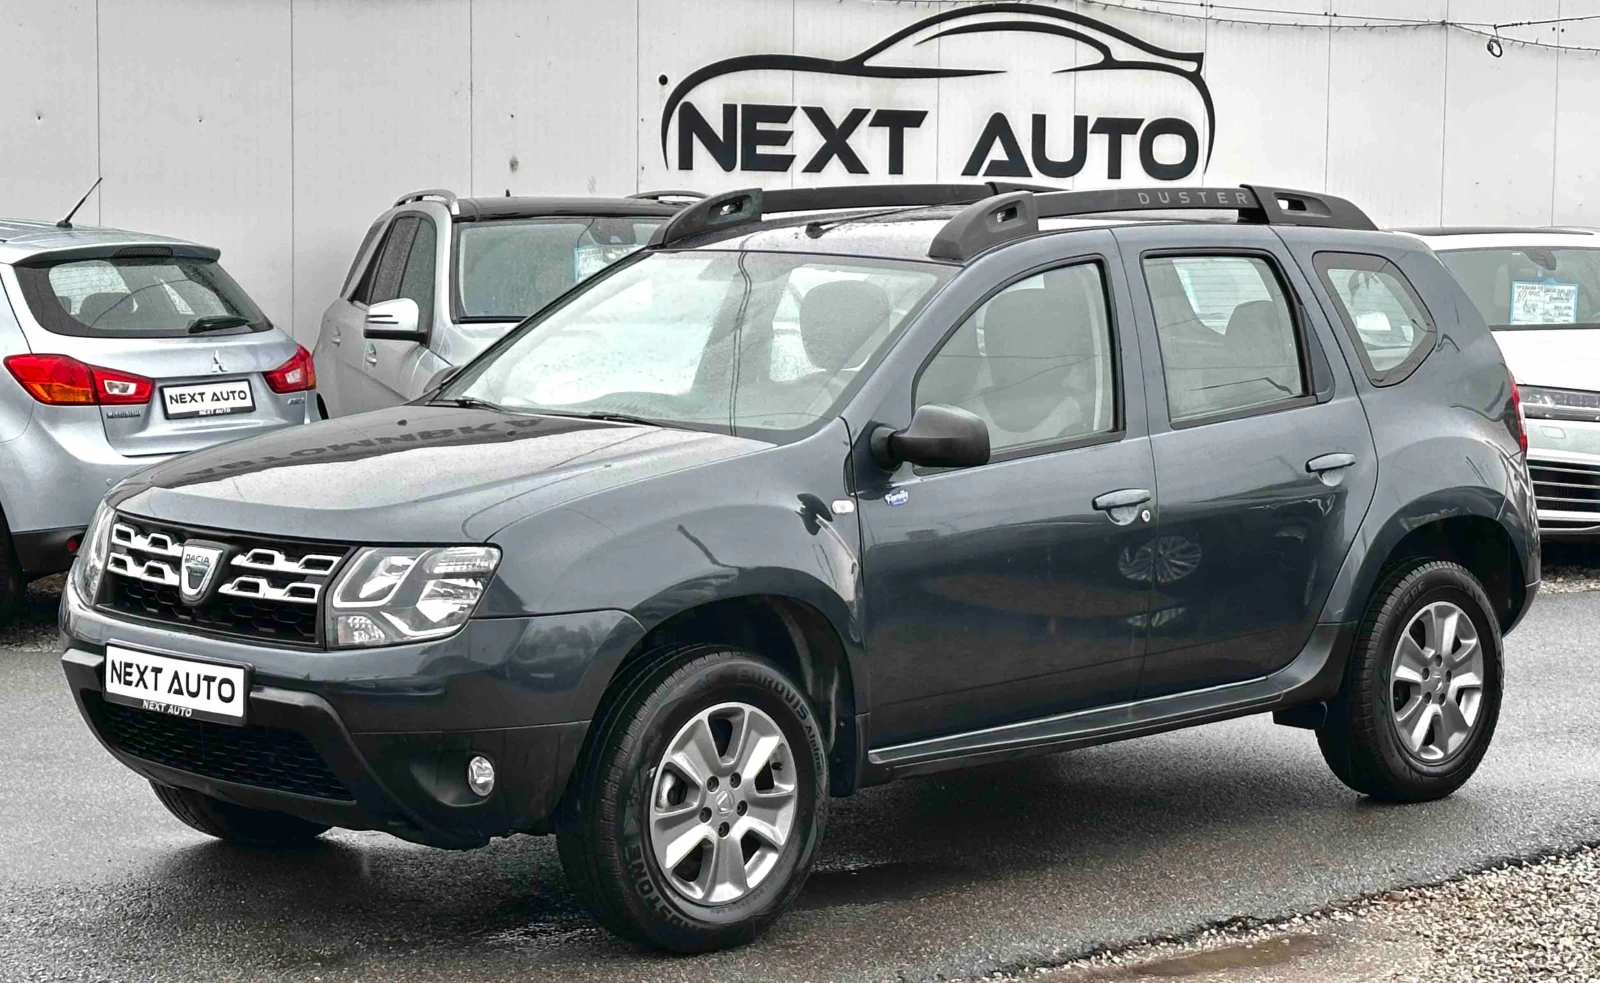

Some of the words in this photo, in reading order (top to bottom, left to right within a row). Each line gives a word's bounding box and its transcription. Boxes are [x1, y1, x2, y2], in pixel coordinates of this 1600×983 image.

[678, 101, 928, 174] NEXT
[962, 111, 1199, 181] AUTO
[1138, 191, 1249, 205] DUSTER
[169, 391, 206, 405] NEXT
[210, 389, 248, 402] AUTO
[185, 553, 211, 565] DACIA
[111, 660, 164, 692] NEXT
[167, 669, 236, 704] AUTO
[142, 700, 167, 713] NEXT
[167, 704, 193, 718] AUTO
